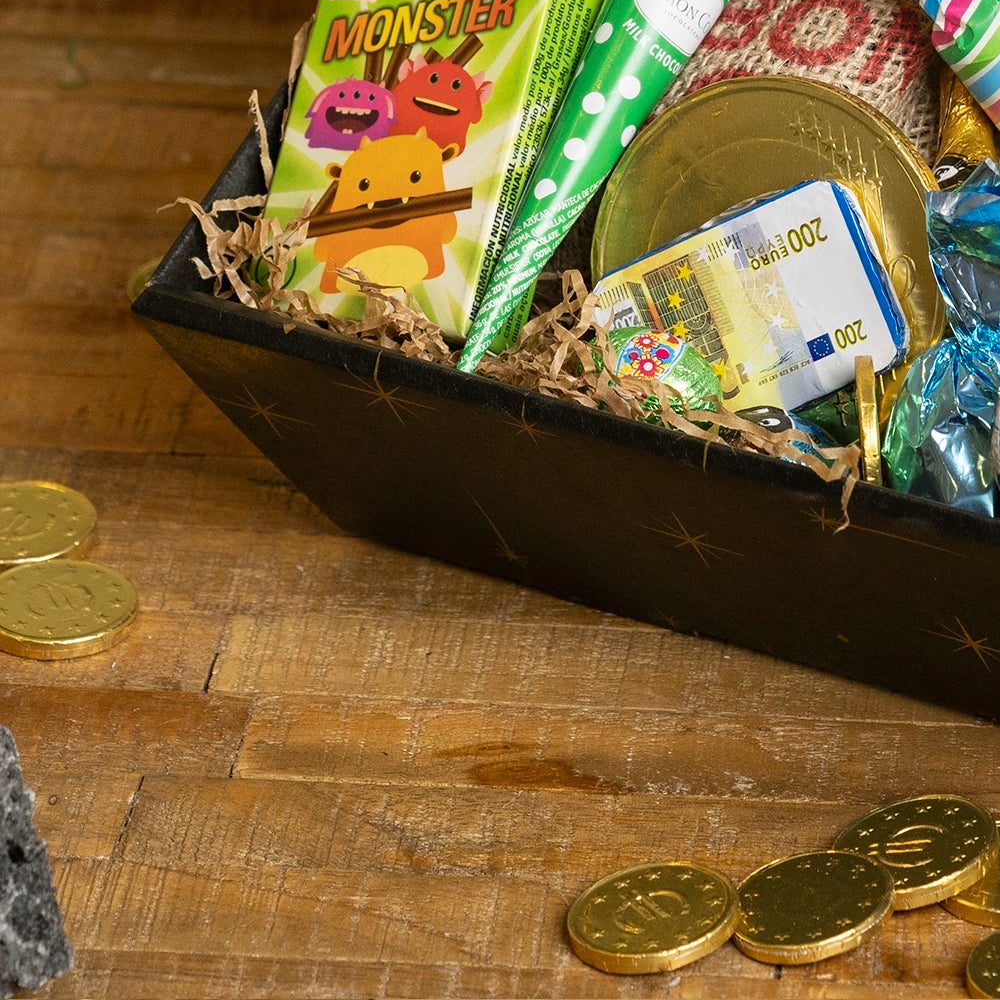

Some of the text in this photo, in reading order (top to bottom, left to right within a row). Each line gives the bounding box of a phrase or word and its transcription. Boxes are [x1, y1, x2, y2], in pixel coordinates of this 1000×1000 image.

[549, 1, 567, 44] produto
[562, 13, 581, 57] Hidratos
[538, 36, 548, 51] de
[545, 44, 555, 59] de
[622, 18, 685, 75] MILK CHOCO
[531, 52, 545, 76] 100g
[538, 60, 552, 84] 100g
[556, 65, 570, 84] 34g
[527, 77, 538, 98] por
[533, 86, 545, 106] por
[539, 77, 556, 118] 573kcal
[518, 98, 533, 132] medio
[524, 106, 539, 140] médio
[511, 132, 523, 160] valor
[517, 140, 531, 169] valor
[488, 160, 517, 240] NUTRICIONAL
[580, 187, 590, 198] DE
[495, 170, 522, 246] NUTRICIONAL
[505, 231, 531, 250] AROMA
[747, 216, 829, 271] 200 EURO
[501, 249, 520, 263] MILK
[467, 239, 496, 321] INFORMACIÓN
[830, 318, 869, 350] 200
